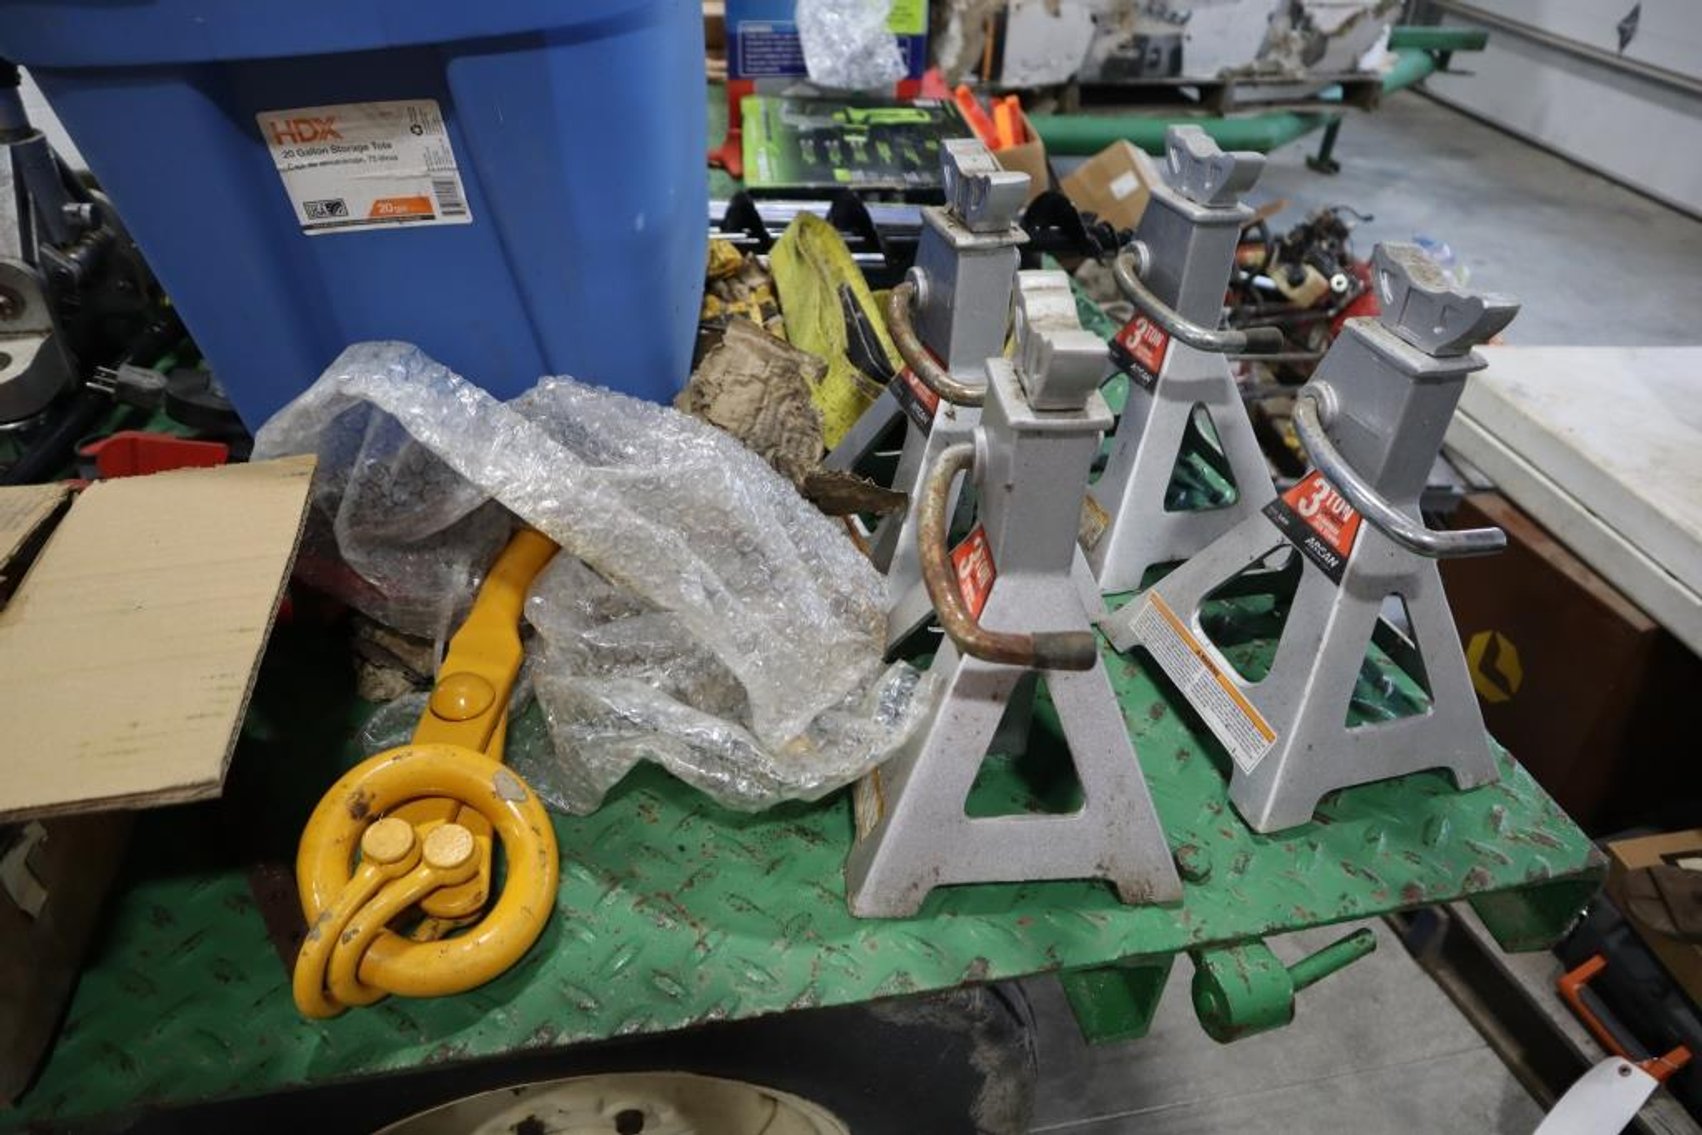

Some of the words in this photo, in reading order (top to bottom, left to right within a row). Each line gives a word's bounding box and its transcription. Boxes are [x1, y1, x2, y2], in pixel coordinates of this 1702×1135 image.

[270, 115, 344, 145] HDX
[282, 150, 295, 159] 20
[299, 146, 329, 158] Gallon
[331, 143, 370, 154] Storage
[372, 140, 393, 151] Tote
[377, 202, 393, 213] 20
[1297, 477, 1331, 517] 3
[1326, 489, 1354, 522] TON
[1304, 536, 1340, 568] ARCAN
